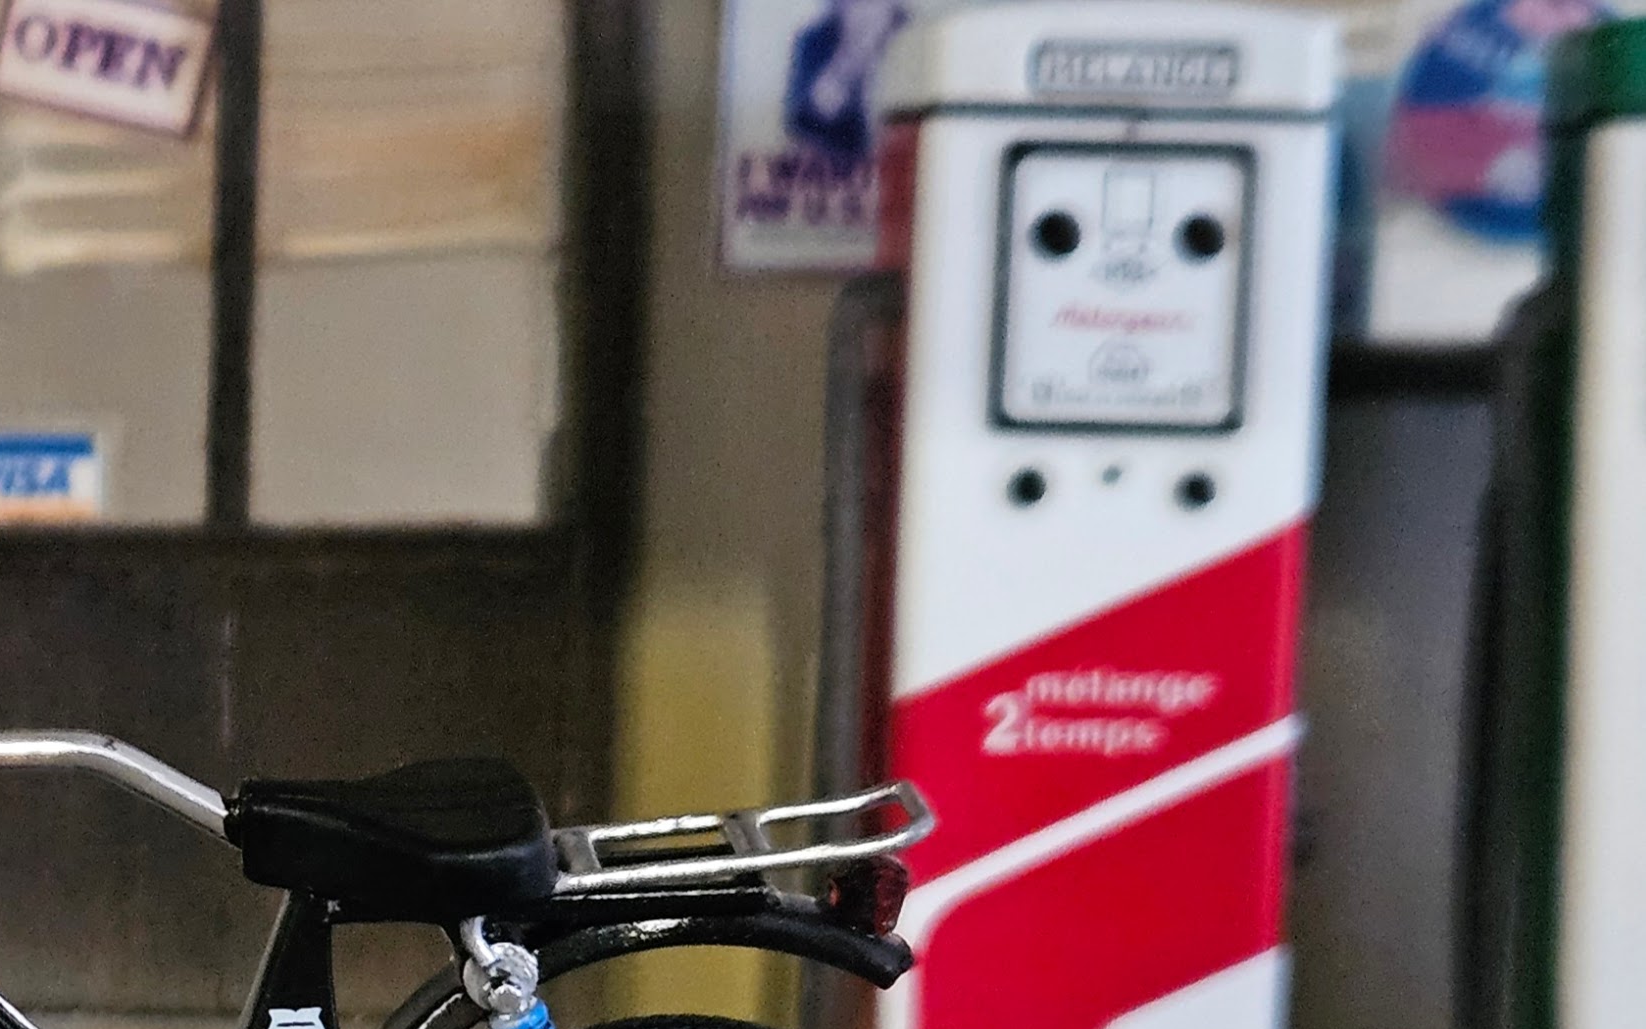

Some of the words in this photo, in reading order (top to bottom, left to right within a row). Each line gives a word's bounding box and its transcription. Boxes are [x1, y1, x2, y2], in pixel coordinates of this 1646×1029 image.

[14, 14, 187, 90] OPEN
[981, 690, 1020, 756] 2
[1023, 717, 1166, 757] temps
